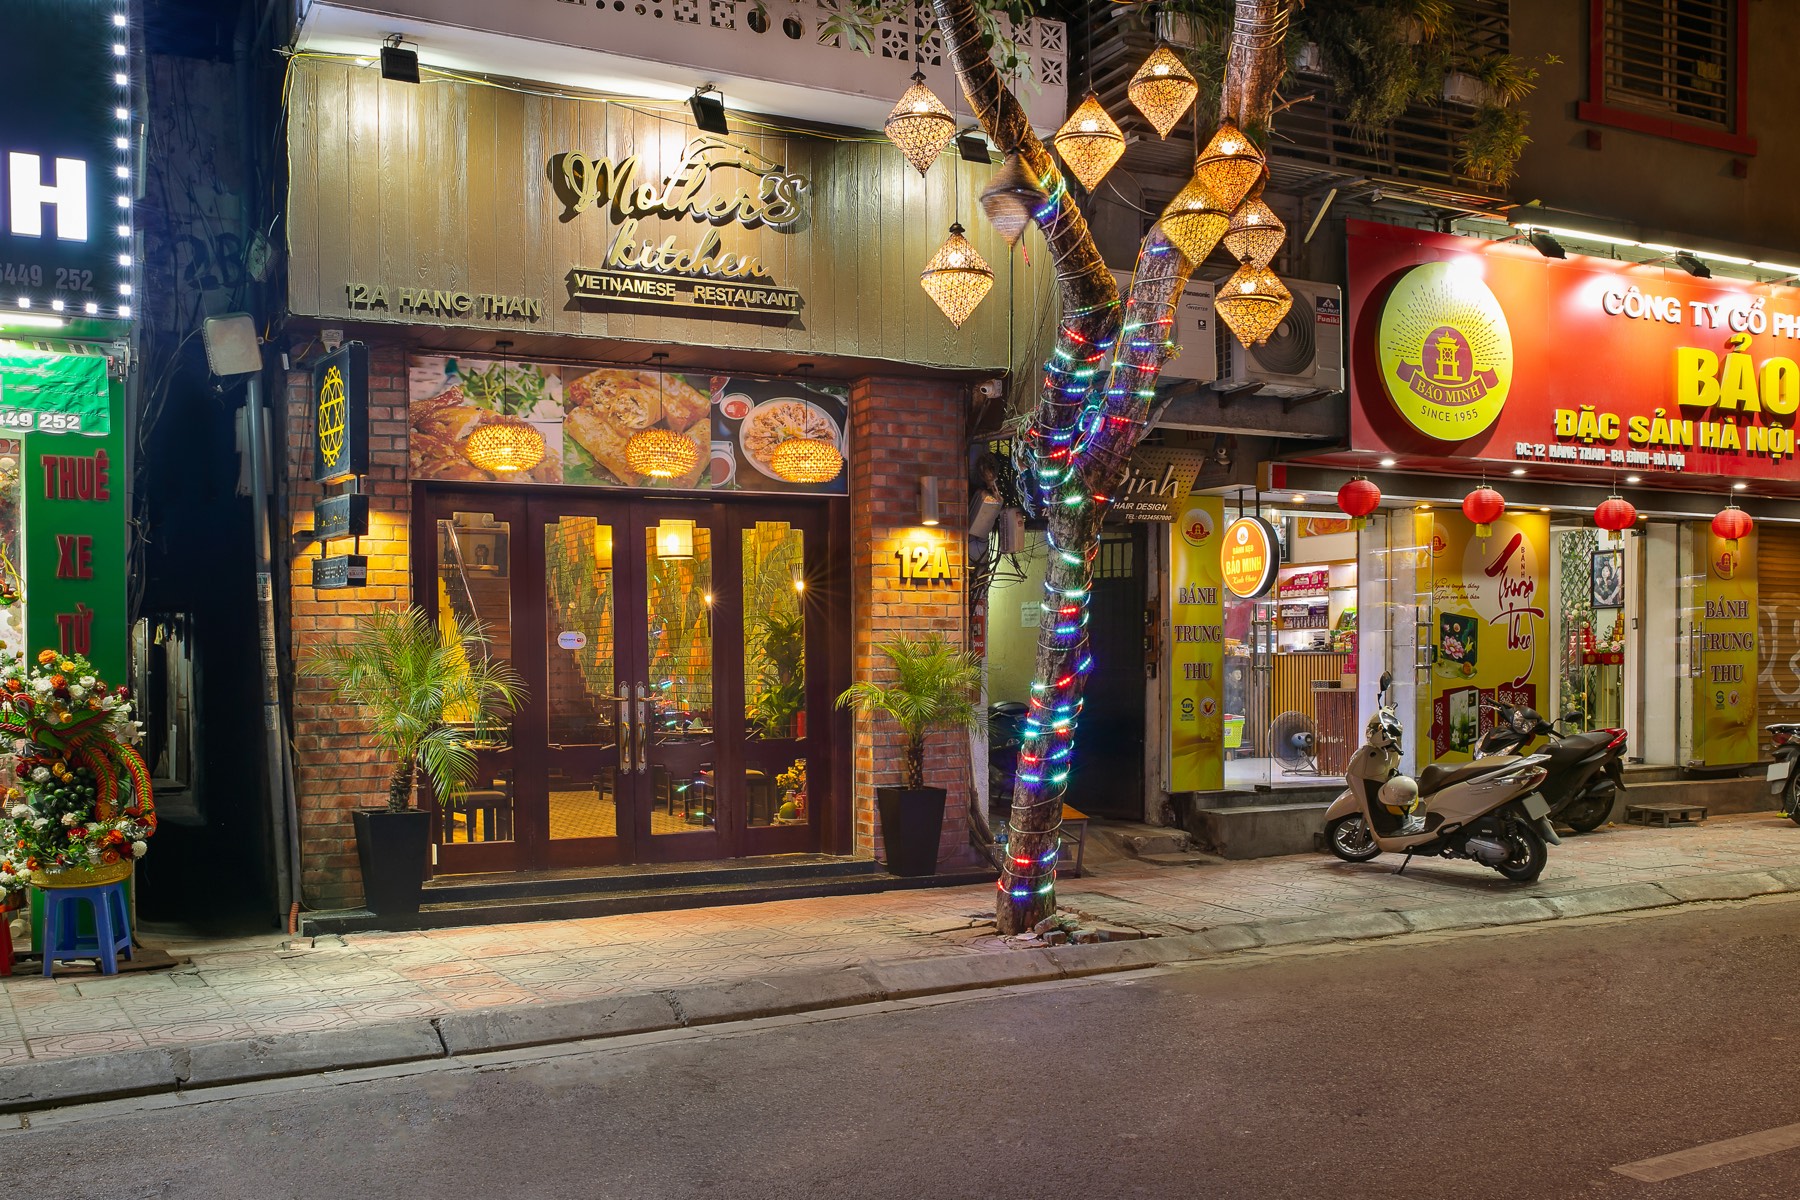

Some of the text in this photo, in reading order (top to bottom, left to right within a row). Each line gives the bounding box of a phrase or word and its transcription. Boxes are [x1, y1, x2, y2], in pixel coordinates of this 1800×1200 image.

[9, 152, 88, 243] H
[610, 219, 770, 278] kitchen
[0, 263, 94, 292] 449 252
[346, 282, 542, 317] 12A HANG THAN
[575, 273, 799, 308] VIETNAMESE RESTAURANT
[1182, 289, 1211, 299] Panasonic
[1317, 314, 1340, 324] Funiki
[1603, 286, 1682, 325] CÔNG
[1689, 301, 1722, 329] TY
[1729, 298, 1768, 335] CỔ
[1677, 332, 1800, 415] BẢO
[1445, 384, 1481, 403] MINH
[39, 413, 81, 430] 252
[1421, 405, 1479, 422] SINCE 1955
[1554, 404, 1795, 459] ĐẶC SẢN HÀ NỘI
[40, 448, 110, 501] THUÊ
[1113, 502, 1169, 511] HAIR DESIGN
[55, 534, 94, 579] XE
[897, 546, 951, 579] 12A
[1225, 555, 1262, 576] BẢO MINH
[1178, 582, 1217, 604] BÁNH
[1705, 596, 1748, 618] BÁNH
[1174, 625, 1222, 642] TRUNG
[1702, 632, 1753, 650] TRUNG
[1183, 663, 1213, 680] THU
[1711, 664, 1743, 682] THU
